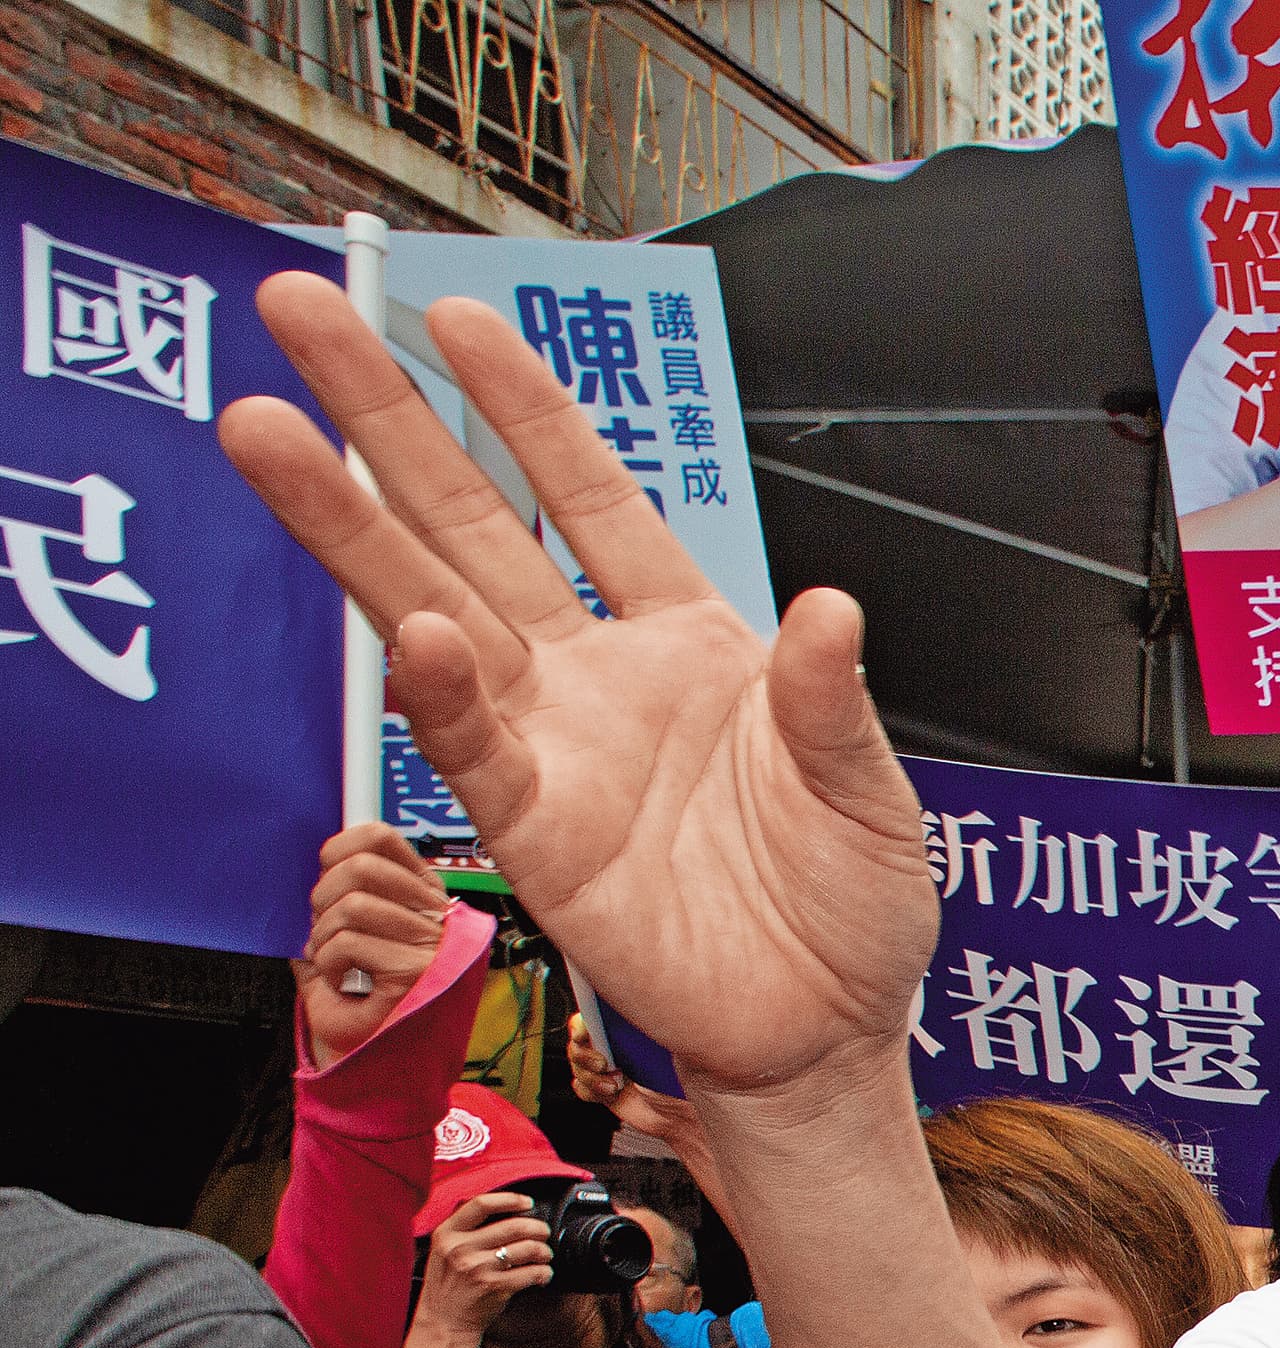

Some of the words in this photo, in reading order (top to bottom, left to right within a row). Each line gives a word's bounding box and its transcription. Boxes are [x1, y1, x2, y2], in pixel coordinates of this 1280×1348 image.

[20, 222, 220, 423] 國
[647, 290, 727, 507] 議員牽成
